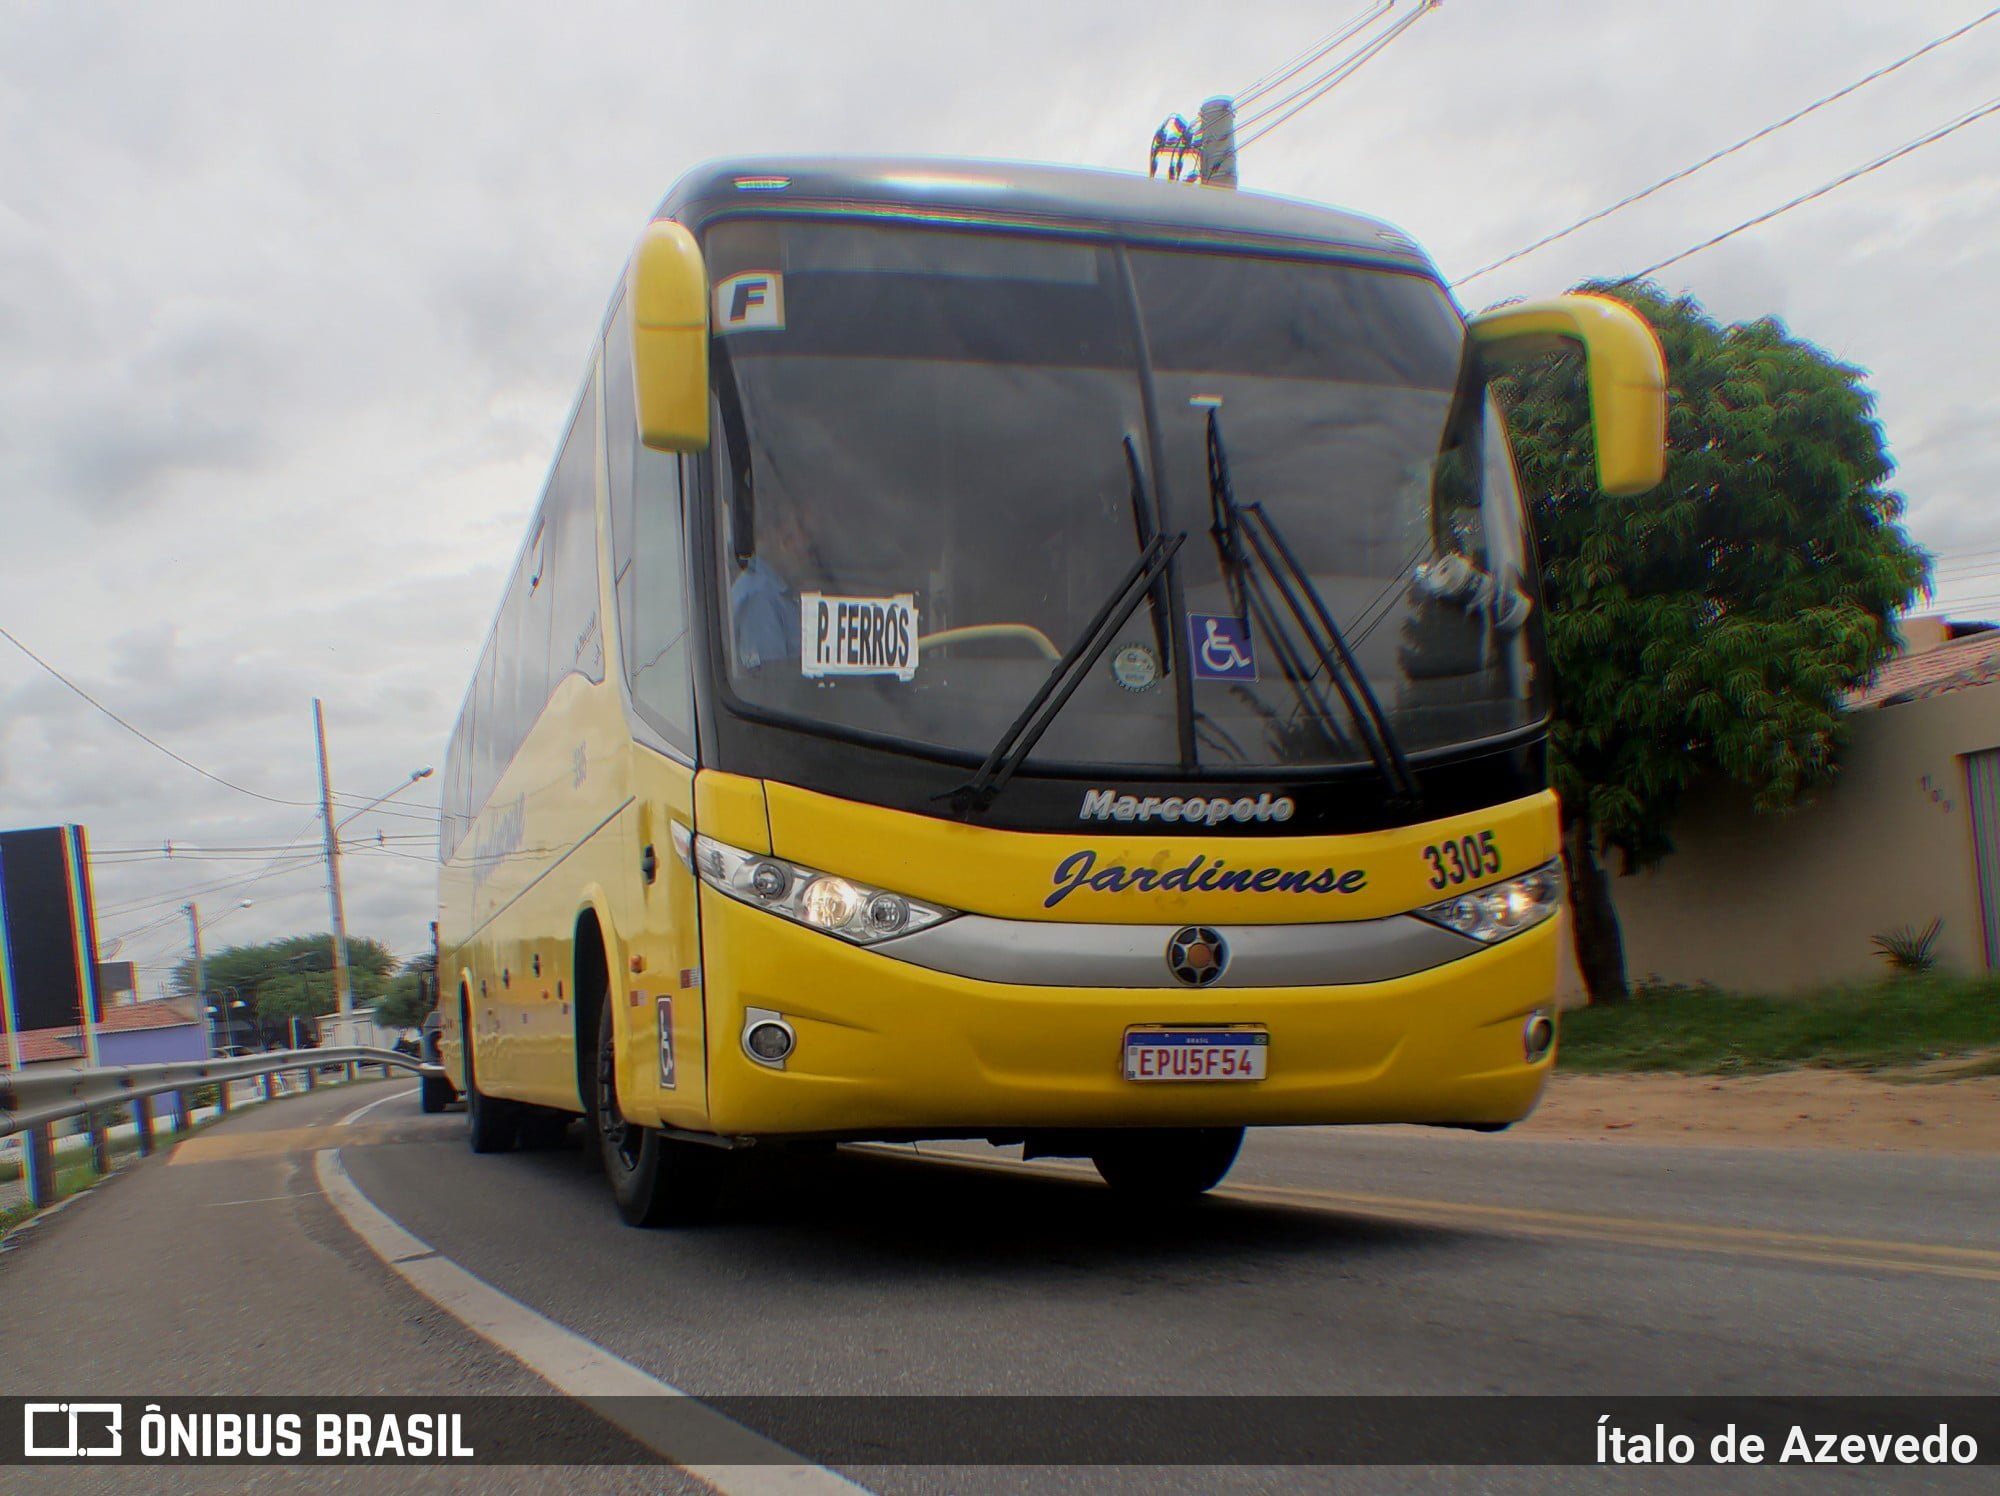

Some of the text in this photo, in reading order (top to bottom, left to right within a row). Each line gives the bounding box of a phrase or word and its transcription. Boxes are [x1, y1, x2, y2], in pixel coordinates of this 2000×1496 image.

[730, 278, 768, 322] F
[817, 601, 909, 667] P. FERROS
[1079, 788, 1295, 826] Marcopolo
[1044, 849, 1368, 908] Jardinense
[1423, 830, 1500, 890] 3305
[1139, 1048, 1253, 1076] EPU5F54
